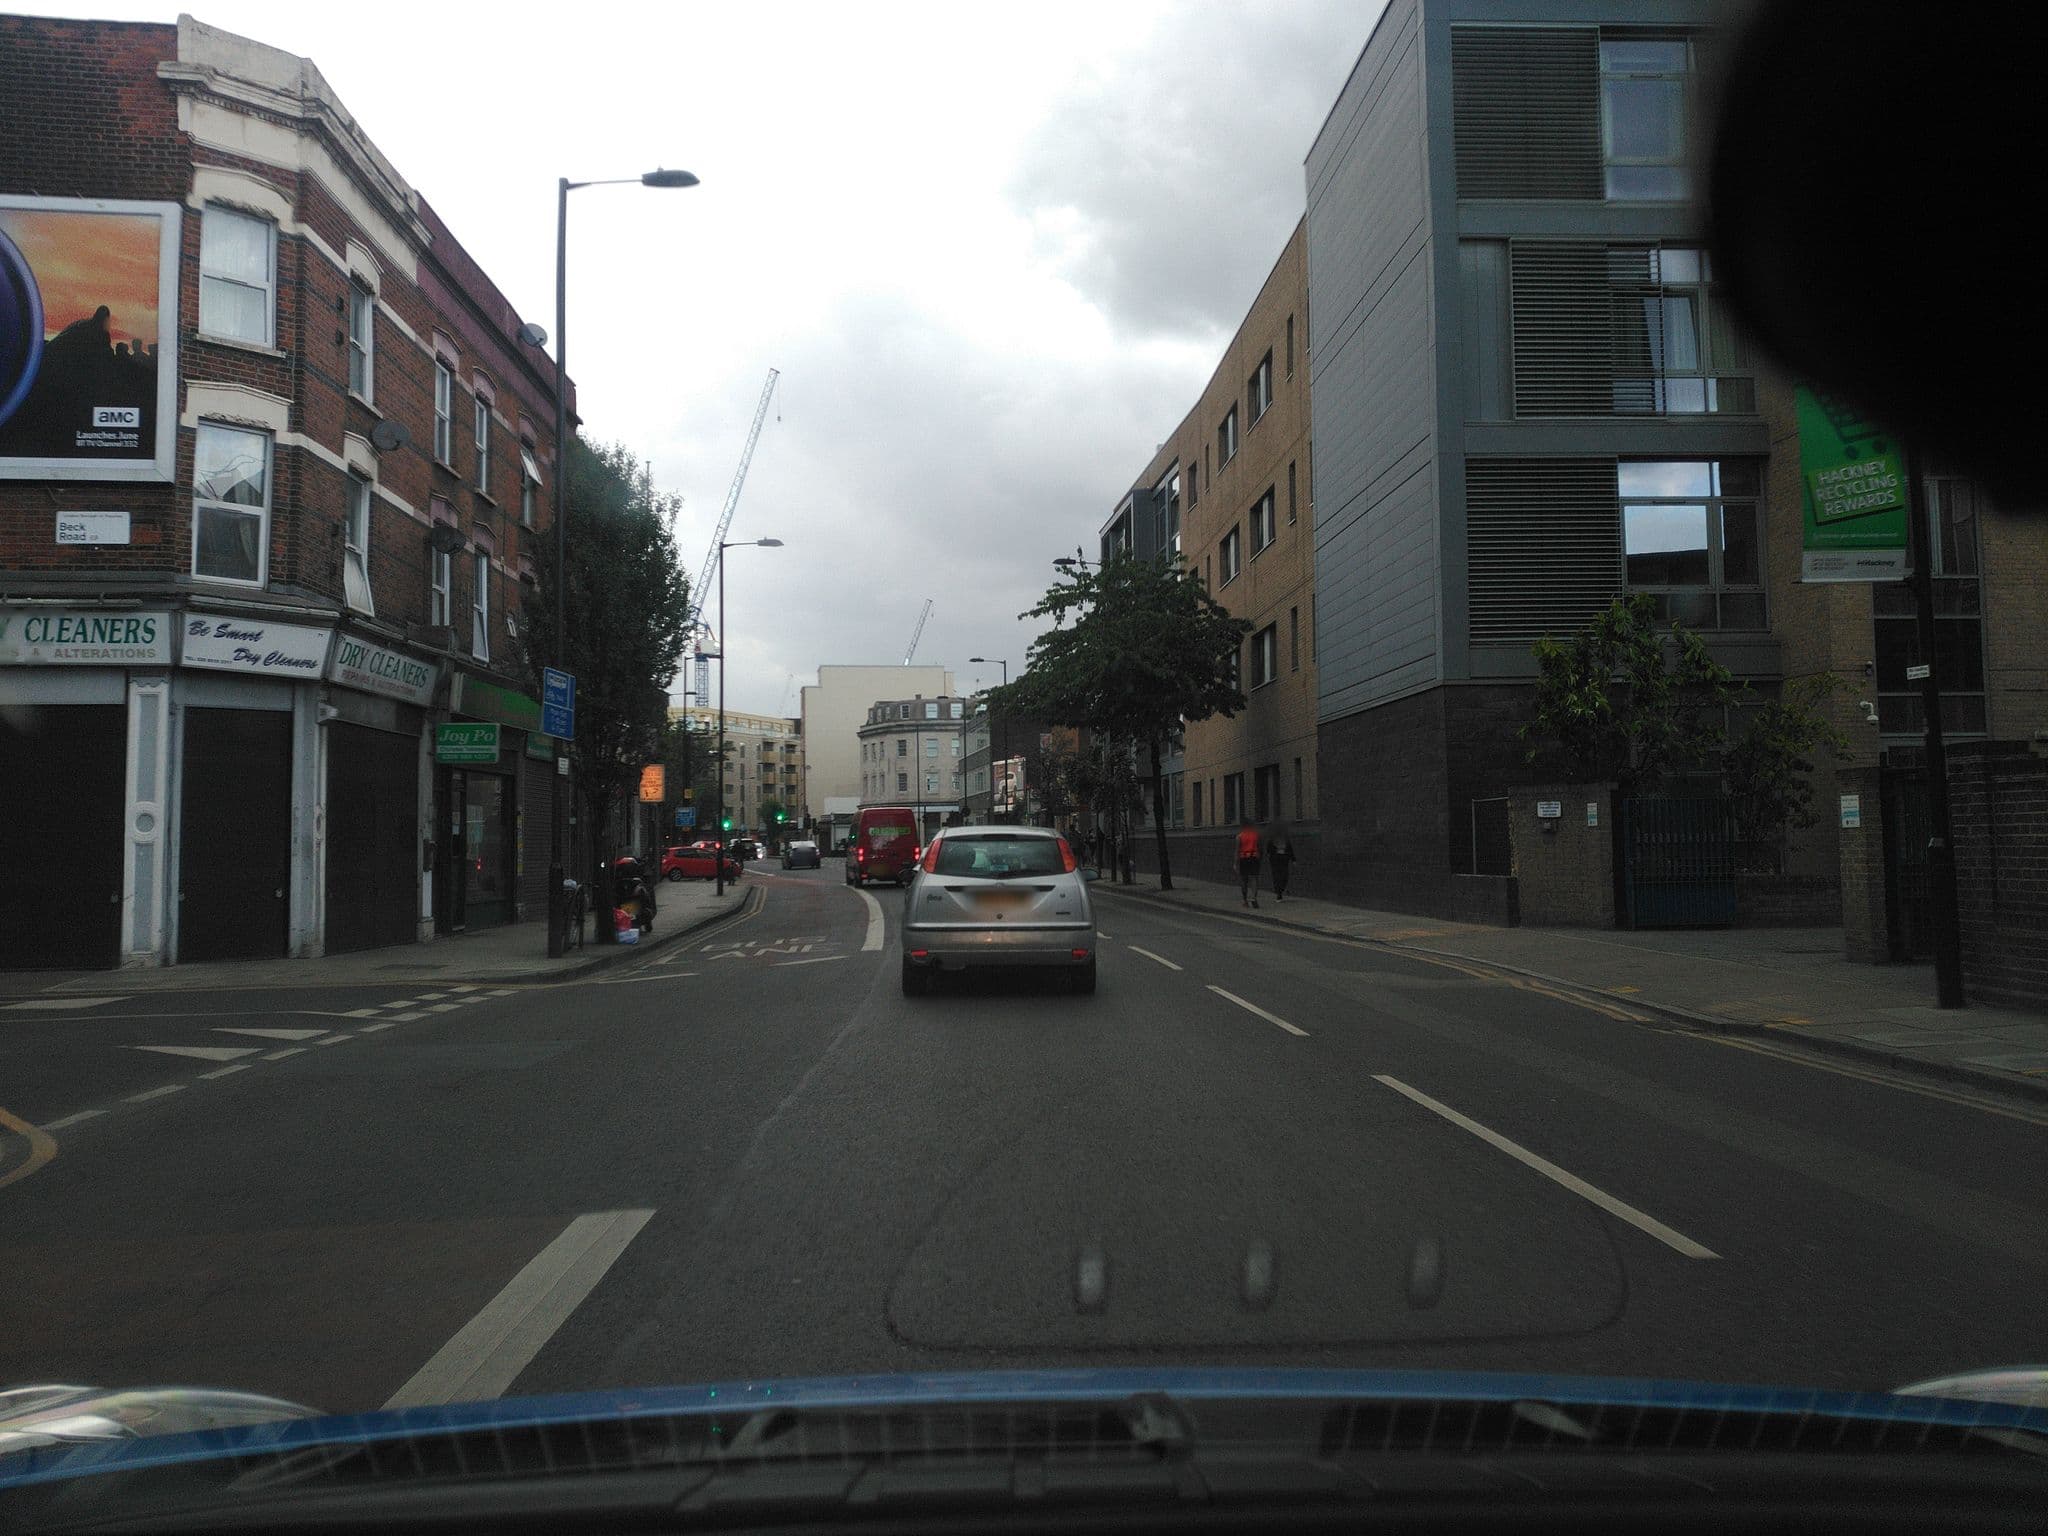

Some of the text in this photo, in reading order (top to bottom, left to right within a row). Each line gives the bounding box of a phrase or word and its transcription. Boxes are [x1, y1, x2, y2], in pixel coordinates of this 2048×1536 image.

[1817, 461, 1886, 484] HACKNEY
[1816, 474, 1898, 502] RECYCLING
[1824, 490, 1897, 516] REWARDS
[59, 522, 86, 531] Beck
[59, 532, 87, 541] Road
[24, 617, 156, 644] CLEANERS
[188, 620, 264, 642] Be Smart
[54, 648, 156, 659] ALTERATIONS
[233, 647, 318, 669] Dry Cleaners
[339, 642, 370, 669] DRY
[369, 651, 429, 688] CLEANERS
[439, 729, 495, 745] Joy Po
